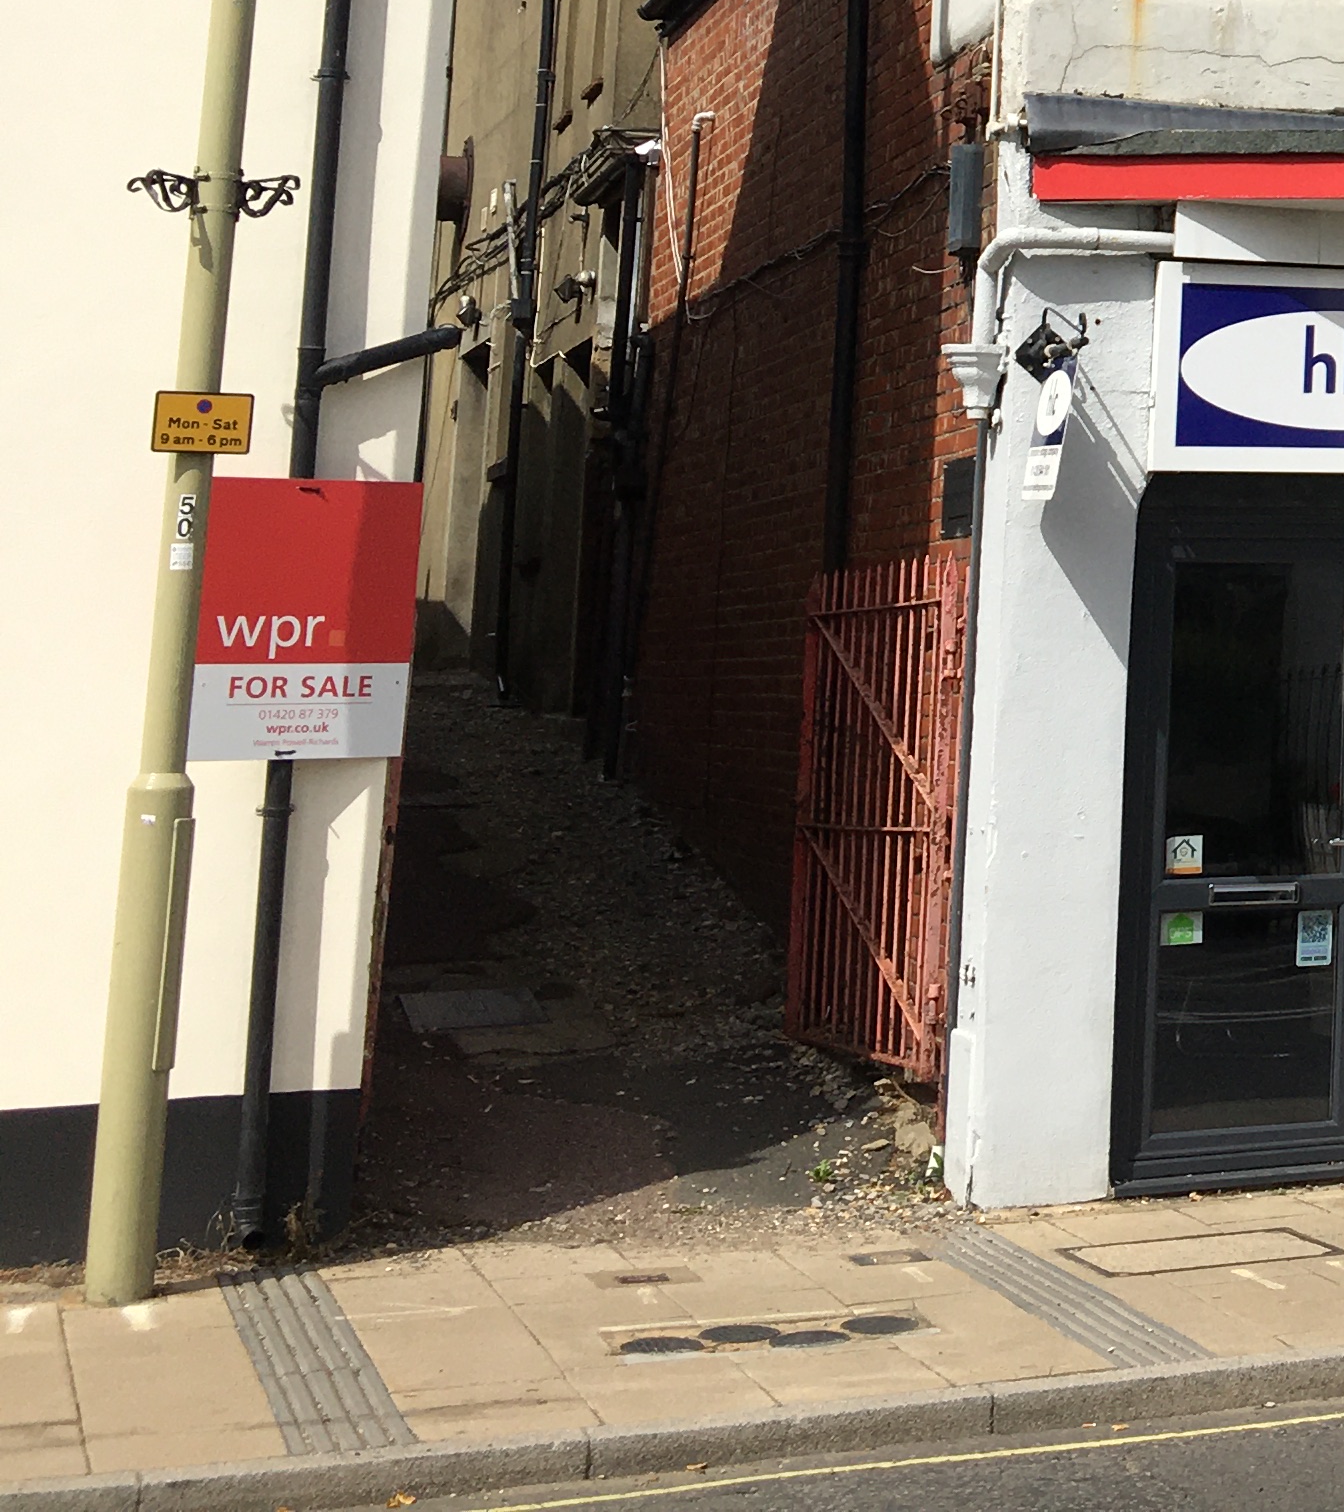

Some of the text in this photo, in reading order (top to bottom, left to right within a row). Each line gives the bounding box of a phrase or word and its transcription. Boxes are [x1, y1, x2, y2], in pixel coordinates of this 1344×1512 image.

[168, 417, 200, 429] Mon
[212, 419, 239, 430] Sat
[160, 433, 169, 444] 9
[173, 436, 195, 445] am
[207, 434, 216, 446] 6
[219, 437, 242, 448] pm
[227, 675, 373, 700] FOR SALE
[258, 708, 339, 720] 01420 87 379
[266, 721, 329, 736] wpr.co.uk
